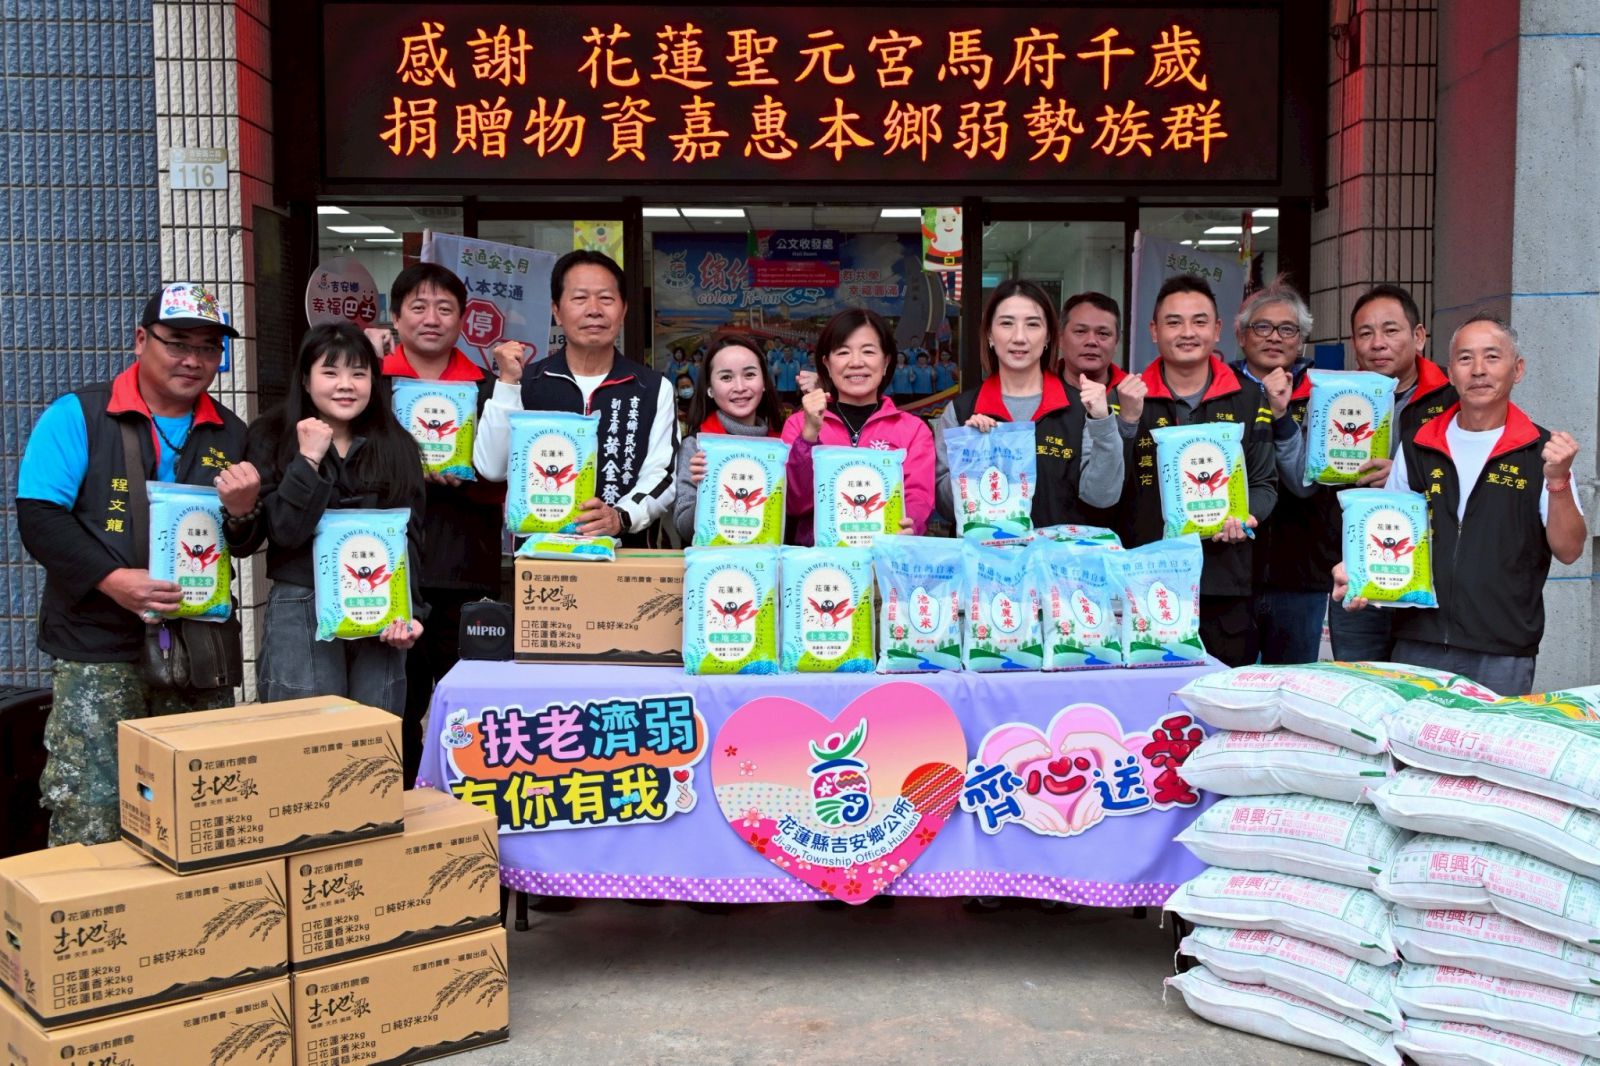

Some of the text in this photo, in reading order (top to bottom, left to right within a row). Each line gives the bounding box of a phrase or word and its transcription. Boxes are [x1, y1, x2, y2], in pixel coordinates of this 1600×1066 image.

[396, 21, 1207, 91] 感謝 花蓮聖元宮馬府千歲
[379, 94, 1229, 164] 捐贈物資嘉惠本鄉弱勢族群
[178, 165, 215, 187] 116
[461, 248, 529, 275] 交通安全月
[331, 281, 359, 292] 吉安鄉
[465, 276, 523, 301] 人本交通
[312, 296, 376, 321] 幸福巴士
[466, 309, 493, 338] 停
[1045, 436, 1063, 446] 花蓮
[1036, 445, 1073, 459] 聖元宮
[1499, 463, 1520, 475] 花蓮
[1486, 472, 1528, 490] 聖元宮
[105, 478, 128, 533] 程文龍
[534, 574, 578, 582] 花蓮市農會
[531, 620, 572, 630] 花蓮米2kg
[531, 630, 581, 639] 花蓮香米2kg
[597, 621, 638, 631] 純好米2kg
[531, 639, 581, 649] 花蓮糙米2kg
[481, 698, 696, 766] 扶老濟弱
[1420, 722, 1481, 750] 順興行
[204, 755, 258, 771] 花蓮市農會
[964, 714, 1204, 830] 齊心送愛
[451, 766, 668, 828] 有你有我
[282, 800, 331, 816] 純好米2kg
[1232, 807, 1284, 826] 順興行
[202, 814, 253, 829] 花蓮米2kg
[777, 797, 914, 854] 花蓮縣吉安鄉公所
[203, 824, 264, 841] 花蓮香米2kg
[203, 834, 264, 853] 花蓮糙米2kg
[773, 835, 798, 857] Ji-an
[800, 850, 852, 867] Township
[314, 858, 363, 875] 花蓮市農會
[1430, 852, 1488, 878] 順興行
[1226, 875, 1281, 891] 順興行
[67, 903, 126, 922] 花蓮市農會
[386, 898, 431, 914] 純好米2kg
[313, 913, 360, 930] 花蓮米2kg
[313, 922, 370, 942] 花蓮香米2kg
[314, 933, 370, 953] 花蓮糙米2kg
[153, 947, 206, 965] 純好米2kg
[66, 964, 121, 982] 花蓮米2kg
[66, 975, 133, 994] 花蓮香米2kg
[320, 976, 370, 995] 花蓮市農會
[67, 986, 133, 1007] 花蓮糙米2kg
[393, 1013, 438, 1032] 純好米2kg
[77, 1034, 134, 1056] 花蓮市農會
[319, 1030, 366, 1049] 花蓮米2kg
[319, 1039, 376, 1060] 花蓮香米2kg
